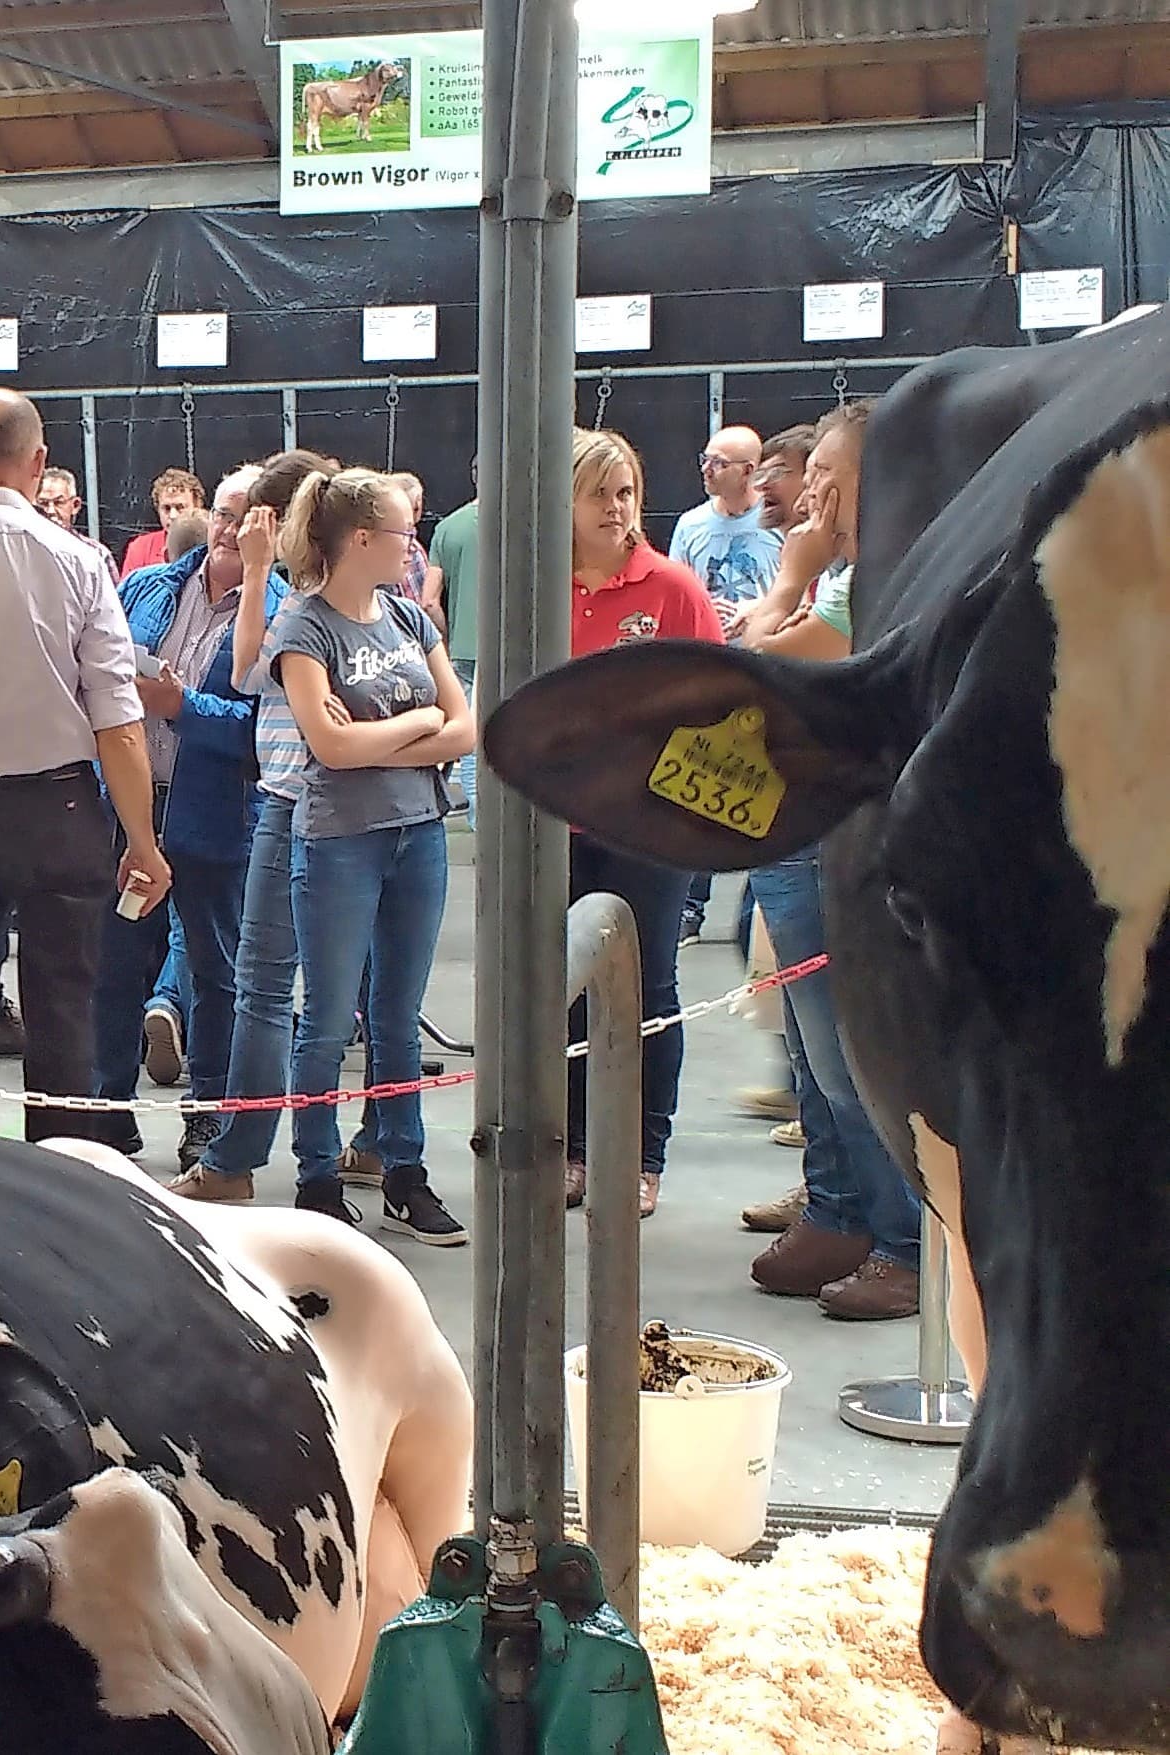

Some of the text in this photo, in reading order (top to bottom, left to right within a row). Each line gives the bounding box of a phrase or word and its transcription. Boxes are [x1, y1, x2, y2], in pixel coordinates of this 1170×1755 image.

[438, 62, 483, 74] Kruislin
[438, 77, 481, 88] Fantasti
[438, 91, 481, 102] Geweldi
[438, 106, 469, 116] Robot
[437, 118, 479, 130] aAa 165
[292, 170, 363, 188] Brown
[371, 164, 430, 187] Vigor
[652, 760, 754, 825] 2536
